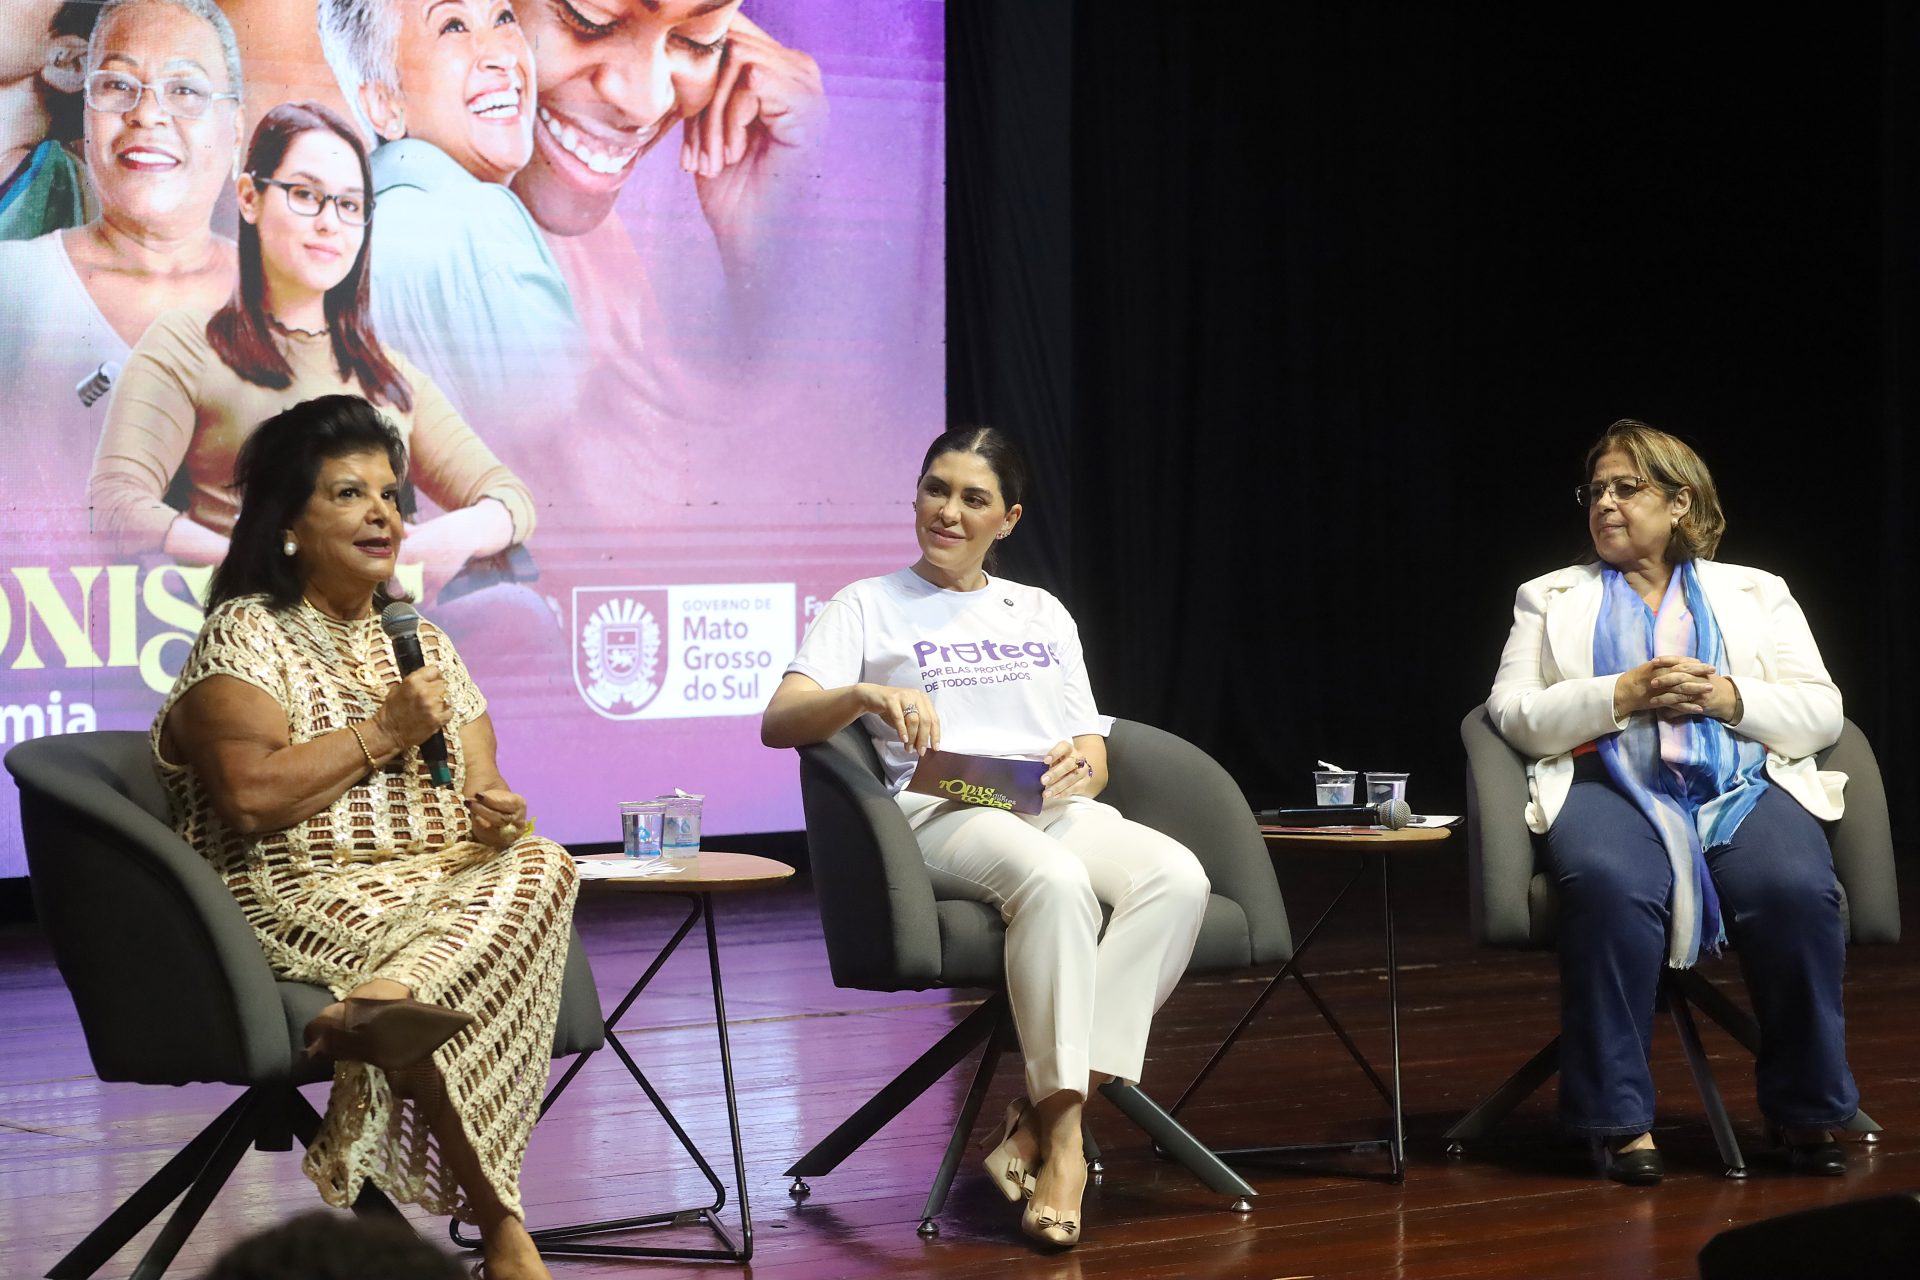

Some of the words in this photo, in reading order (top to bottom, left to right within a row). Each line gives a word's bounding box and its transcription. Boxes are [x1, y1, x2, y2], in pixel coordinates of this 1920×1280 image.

[682, 598, 750, 612] GOVERNO
[755, 598, 772, 610] DE
[683, 616, 749, 641] Mato
[683, 645, 772, 670] Grosso
[913, 639, 1060, 668] Proteg
[921, 667, 944, 680] POR
[925, 681, 939, 693] DE
[942, 677, 978, 688] TODOS
[980, 676, 994, 684] OS
[683, 675, 717, 701] do
[722, 673, 759, 700] Sul
